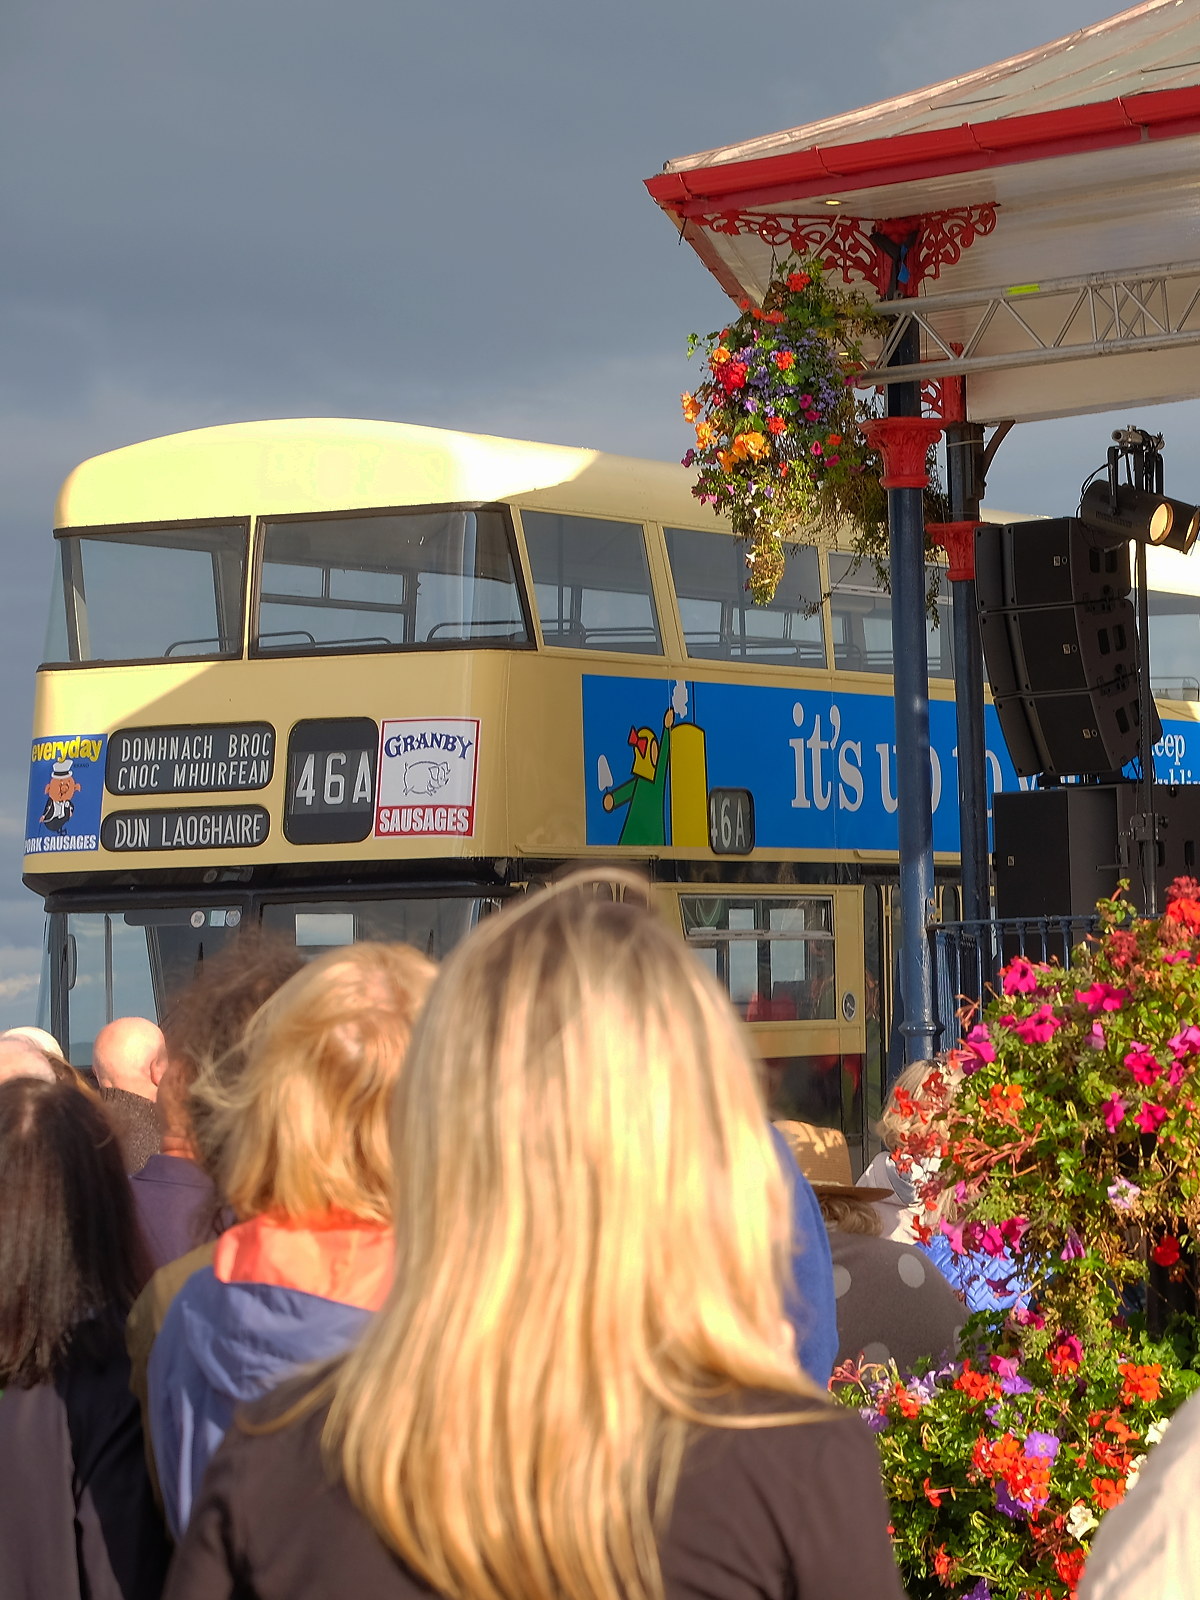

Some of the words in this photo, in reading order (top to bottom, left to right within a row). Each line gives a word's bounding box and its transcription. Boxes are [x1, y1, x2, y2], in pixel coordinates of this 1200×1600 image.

[31, 736, 102, 762] everyday
[121, 735, 213, 762] DOMHNACH
[228, 732, 272, 758] BROC
[384, 731, 473, 760] GRANBY
[789, 702, 864, 812] it's
[1151, 733, 1186, 766] eep
[117, 764, 160, 791] CNOC
[173, 760, 270, 787] MHUIRFEAN
[295, 751, 372, 806] 46A
[114, 817, 150, 848] DUN
[161, 814, 265, 846] LAOGHAIRE
[379, 807, 469, 833] SAUSAGES
[43, 834, 97, 852] SAUSAGES
